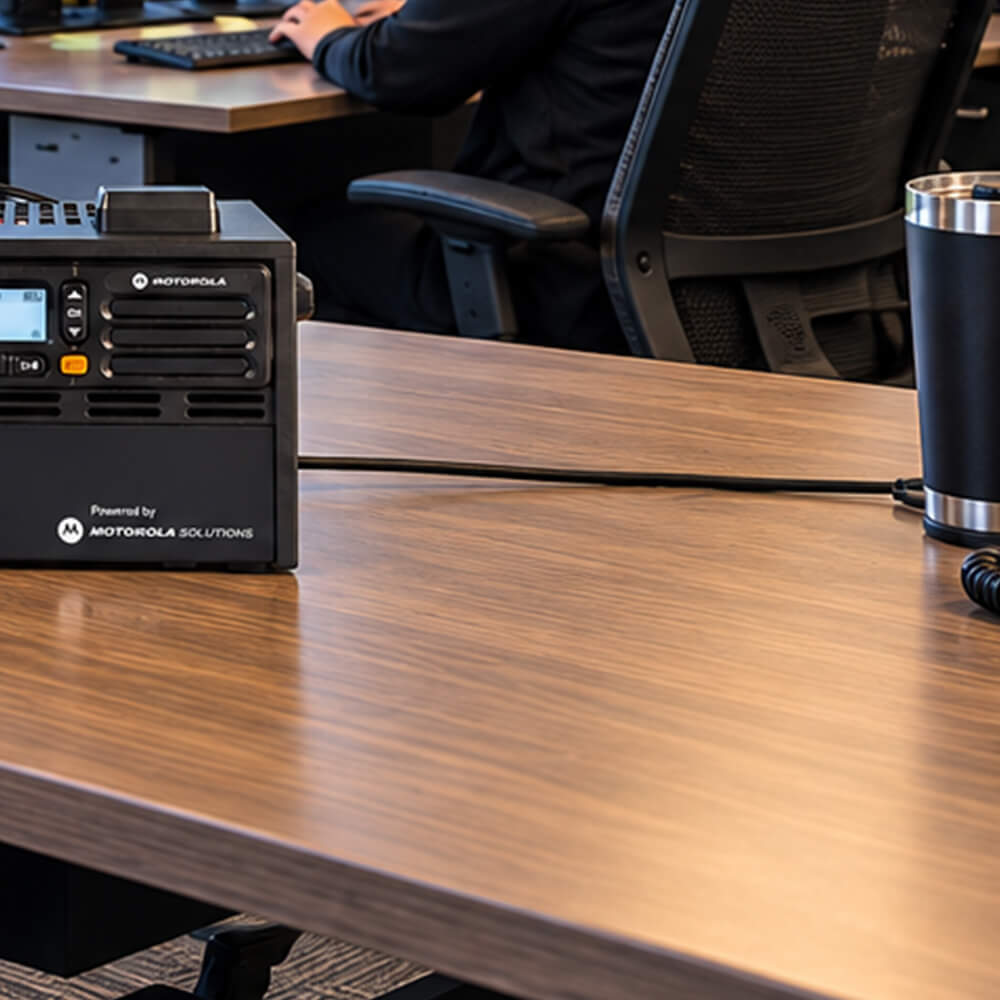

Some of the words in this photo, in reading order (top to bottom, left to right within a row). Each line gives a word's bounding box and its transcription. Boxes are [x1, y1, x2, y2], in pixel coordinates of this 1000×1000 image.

[152, 276, 227, 287] MOTOROLA
[89, 526, 175, 537] MOTOROLA
[179, 527, 254, 540] SOLUTIONS
